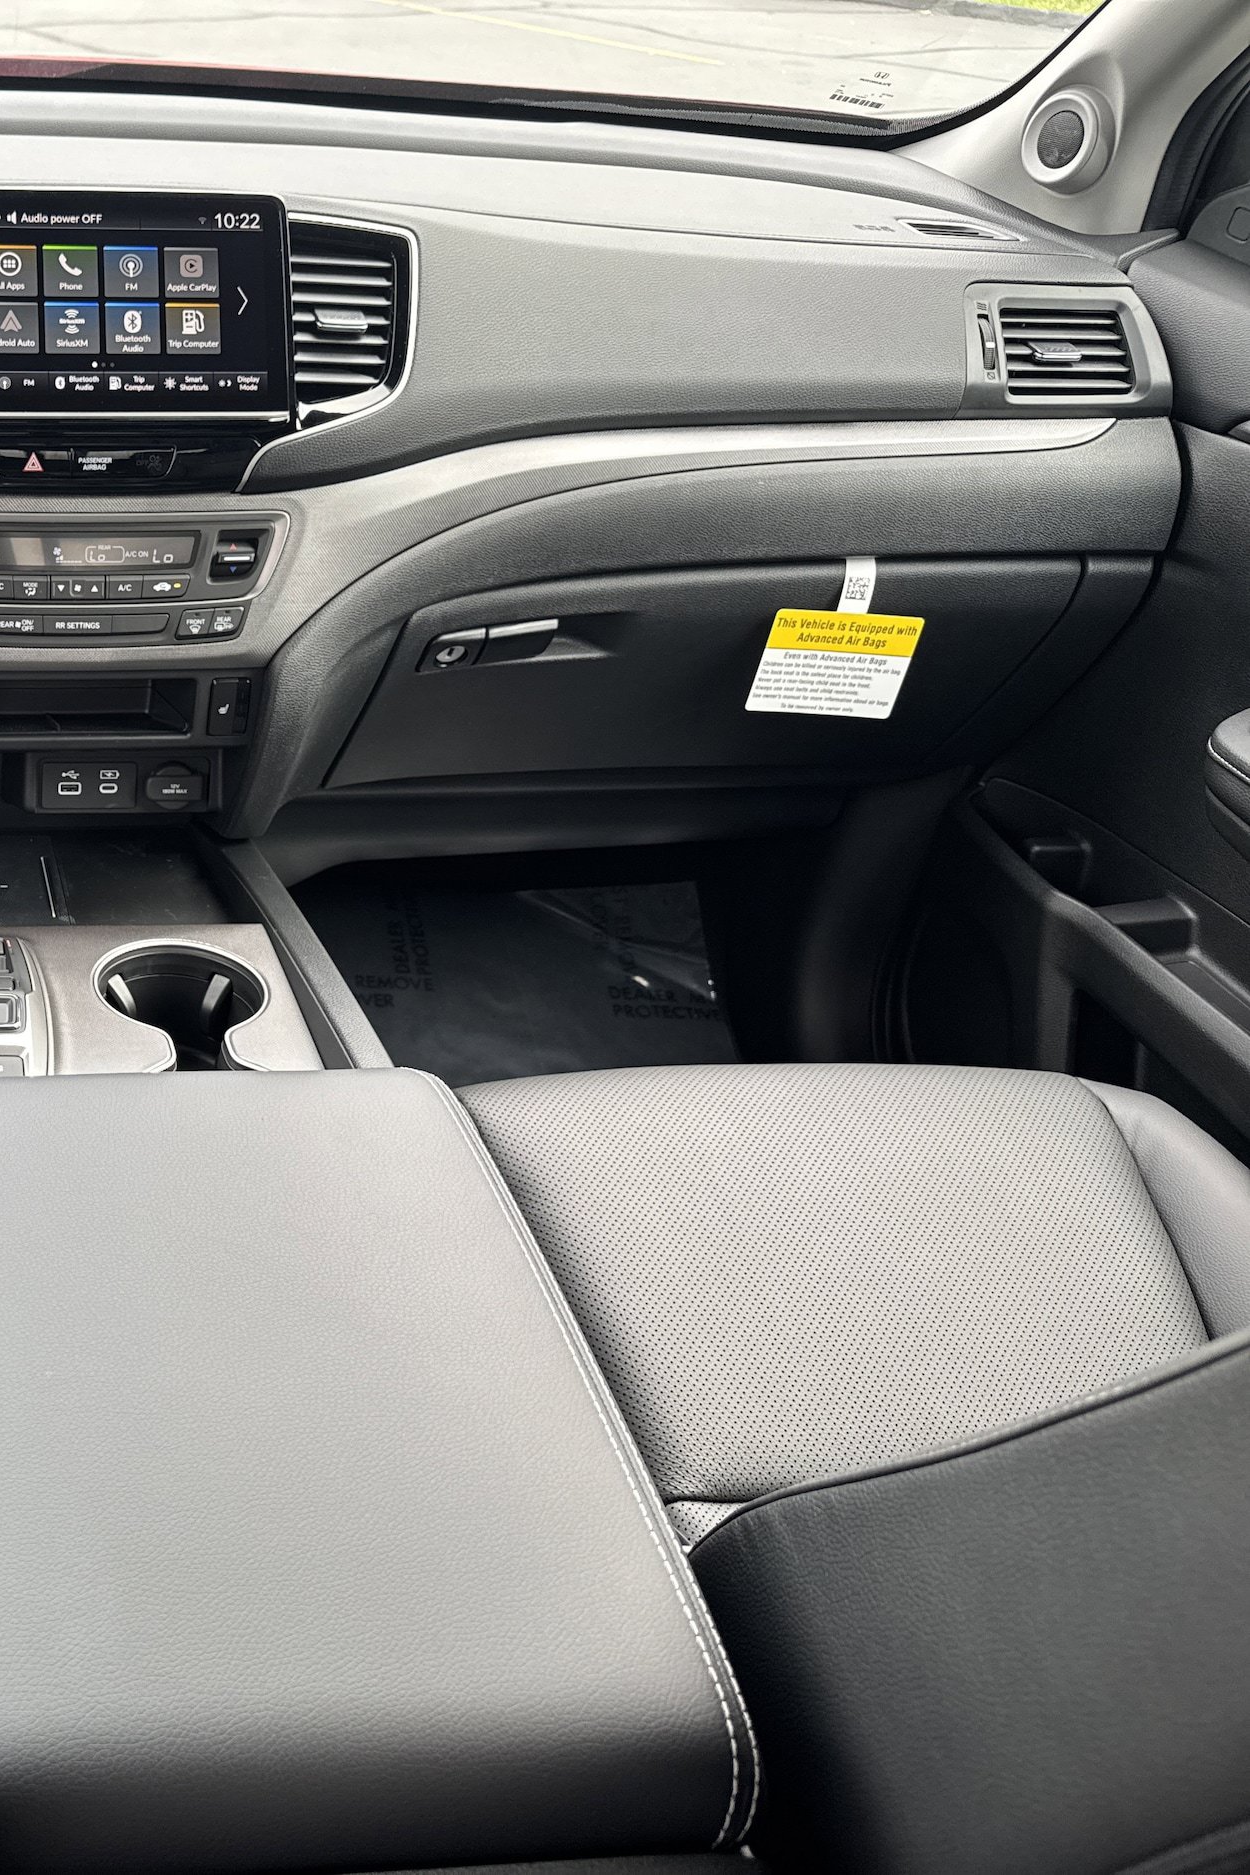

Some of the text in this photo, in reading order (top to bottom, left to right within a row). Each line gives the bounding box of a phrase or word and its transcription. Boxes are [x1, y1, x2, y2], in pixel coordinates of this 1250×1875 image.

[21, 213, 103, 225] Audio power OFF
[214, 212, 261, 229] 10:22
[7, 281, 25, 291] Apps
[59, 282, 83, 291] Phone
[125, 282, 138, 291] FM
[166, 283, 217, 293] Apple CarPlay
[17, 338, 36, 347] Auto
[115, 334, 151, 343] Bluetooth
[56, 339, 89, 348] SiriusXM
[168, 340, 220, 349] Trip Computer
[122, 345, 144, 353] Audio
[23, 379, 35, 387] FM
[69, 375, 100, 383] Bluetooth
[133, 375, 145, 384] Trip
[237, 376, 260, 384] Display
[75, 383, 94, 391] Audio
[124, 383, 155, 392] Computer
[180, 383, 209, 391] Shortcuts
[239, 383, 258, 391] Mode
[117, 584, 133, 592] A/C
[67, 622, 100, 630] SETTINGS
[777, 617, 918, 637] This Vehicle is Equipped with
[796, 632, 887, 649] Advanced Air Bags
[783, 651, 801, 660] Even
[820, 654, 855, 663] Advanced
[856, 656, 867, 664] Air
[869, 658, 887, 666] Bags
